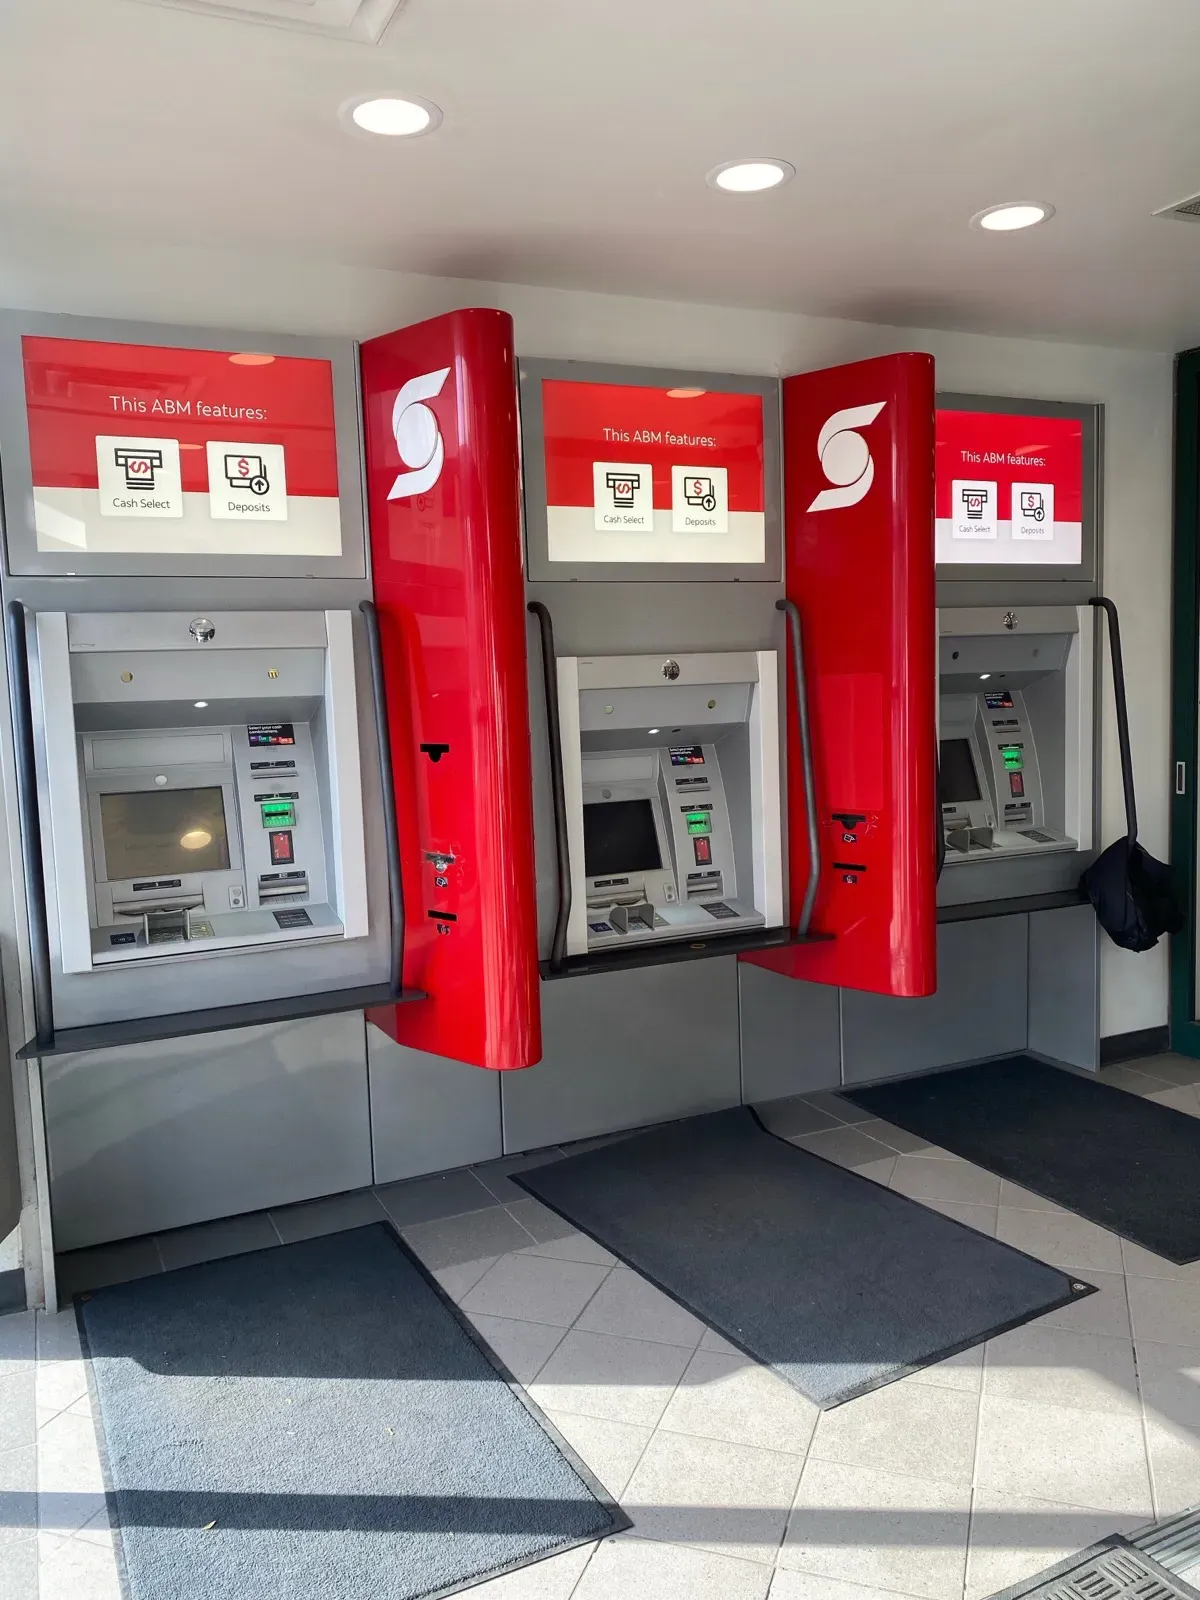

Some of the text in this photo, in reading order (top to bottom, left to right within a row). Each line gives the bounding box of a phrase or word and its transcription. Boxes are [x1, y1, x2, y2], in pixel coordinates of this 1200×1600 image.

[109, 395, 268, 420] This ABM features:
[602, 428, 717, 447] This ABM features:
[960, 450, 1046, 467] This ABM features:
[112, 498, 171, 509] Cash Select
[228, 502, 271, 513] Deposits
[603, 514, 644, 524] Cash Select
[685, 517, 716, 526] Deposits
[959, 524, 991, 533] Cash Select
[1021, 526, 1045, 534] Deposits
